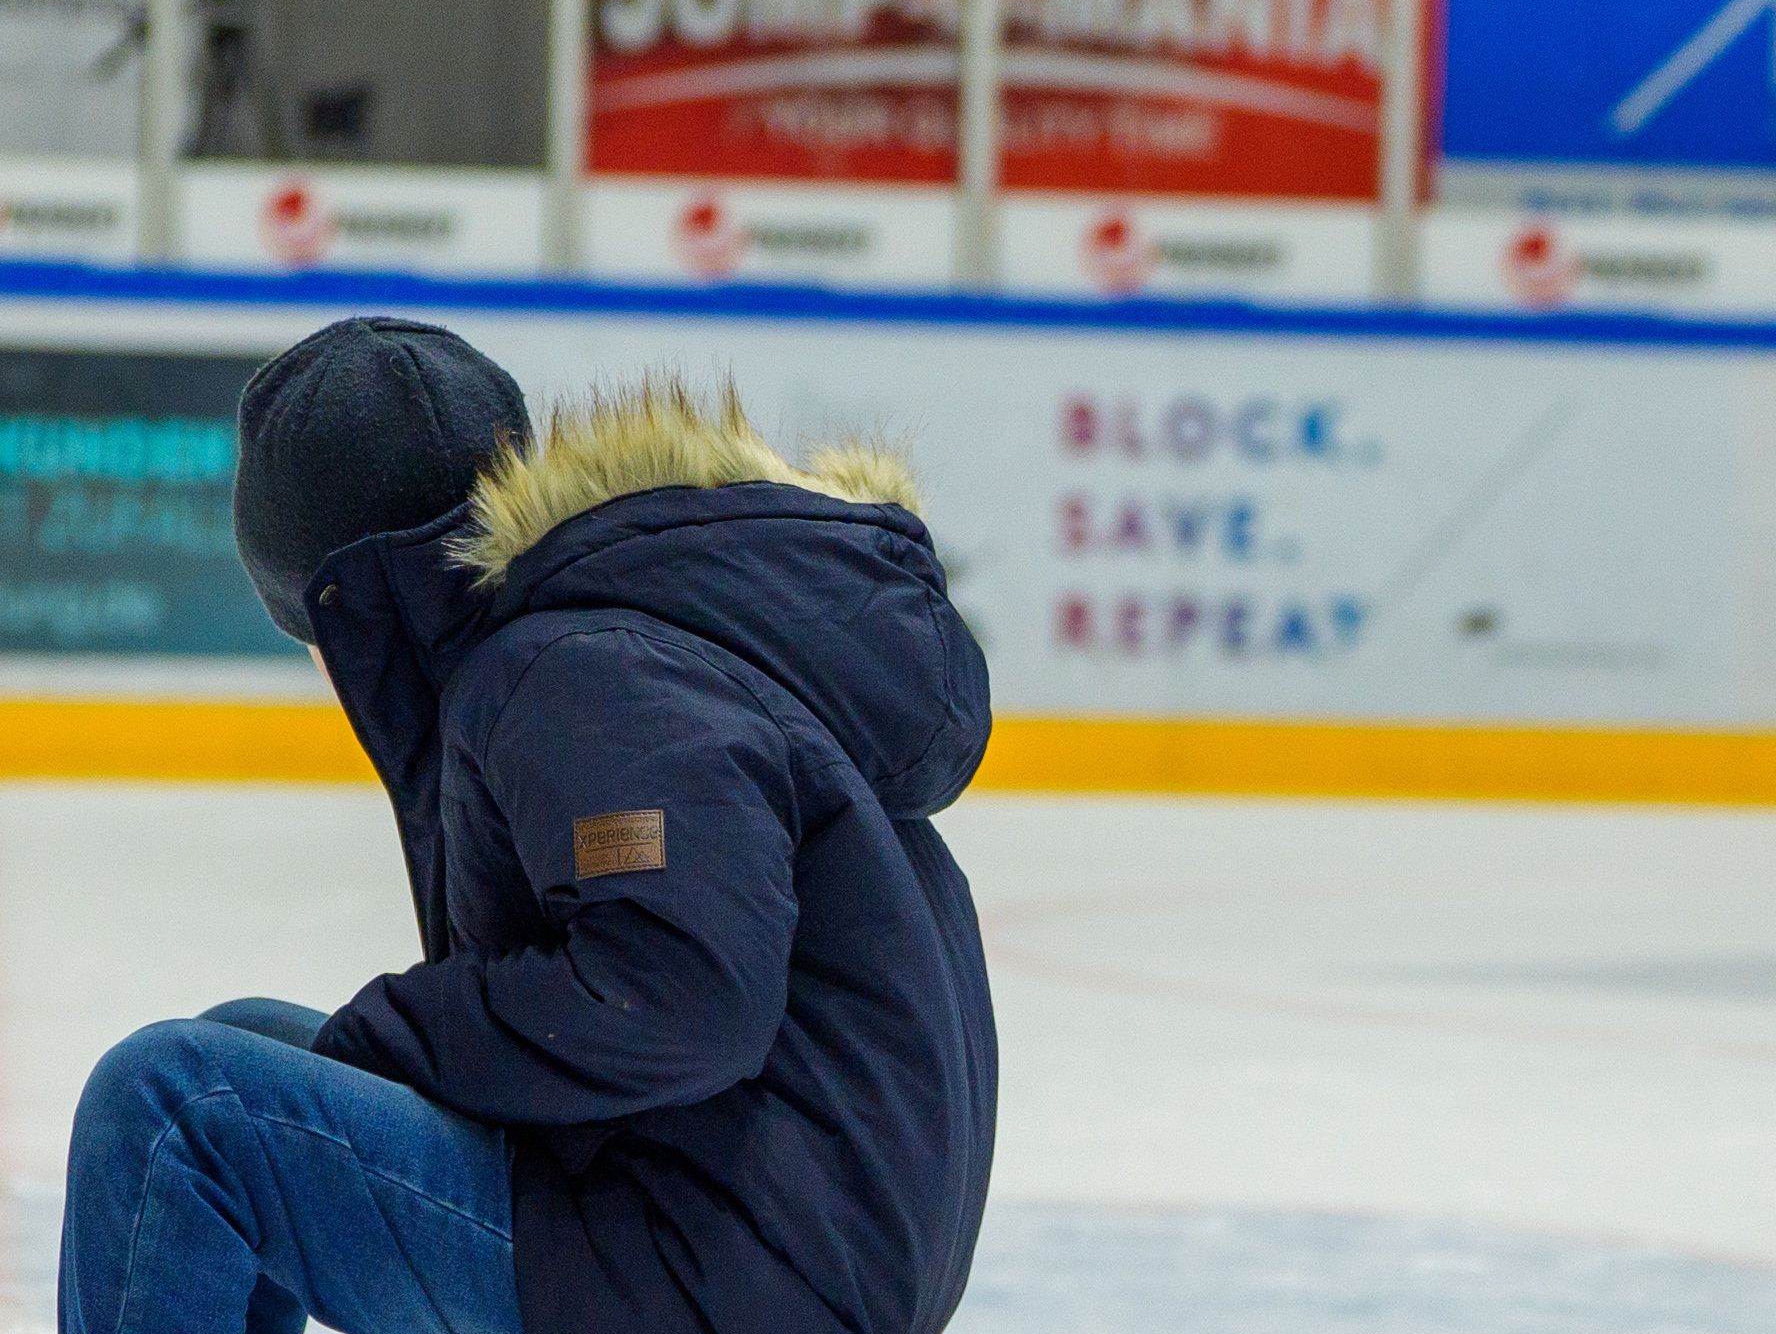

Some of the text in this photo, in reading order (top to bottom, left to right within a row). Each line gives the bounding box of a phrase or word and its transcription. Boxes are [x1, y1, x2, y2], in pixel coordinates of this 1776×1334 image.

[1058, 389, 1384, 467] BLOCK.
[1058, 491, 1304, 565] SAVE.
[1058, 593, 1370, 660] REPEAT
